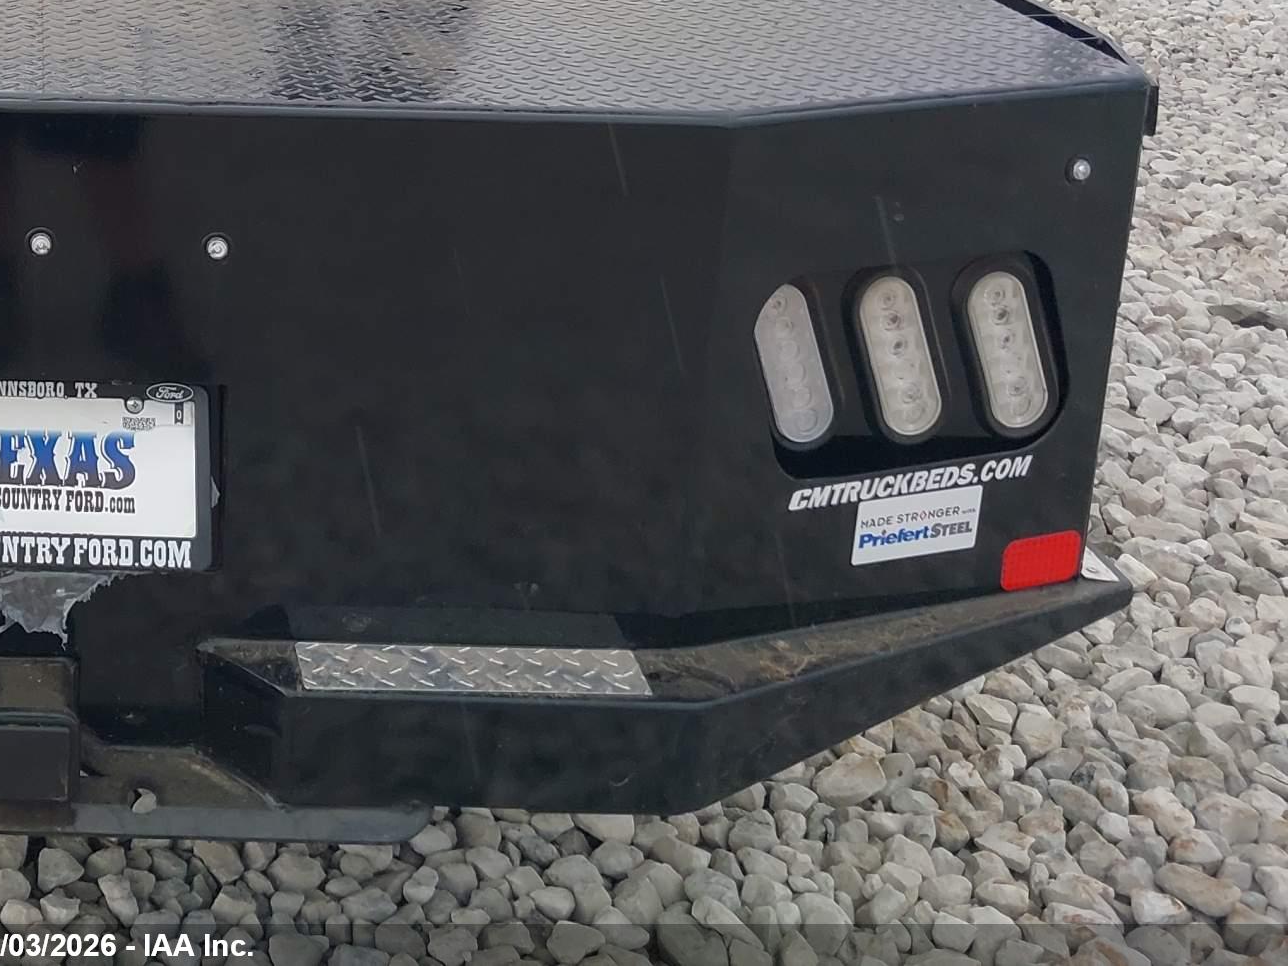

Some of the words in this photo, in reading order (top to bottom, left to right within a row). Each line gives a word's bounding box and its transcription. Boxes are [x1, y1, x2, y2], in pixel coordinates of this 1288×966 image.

[74, 381, 99, 400] TX
[155, 386, 185, 400] Ford
[788, 455, 1033, 511] CMTRUCKBEDS.COM
[65, 488, 136, 514] FORD.com
[860, 515, 895, 529] MADE
[896, 506, 960, 524] STRONGER
